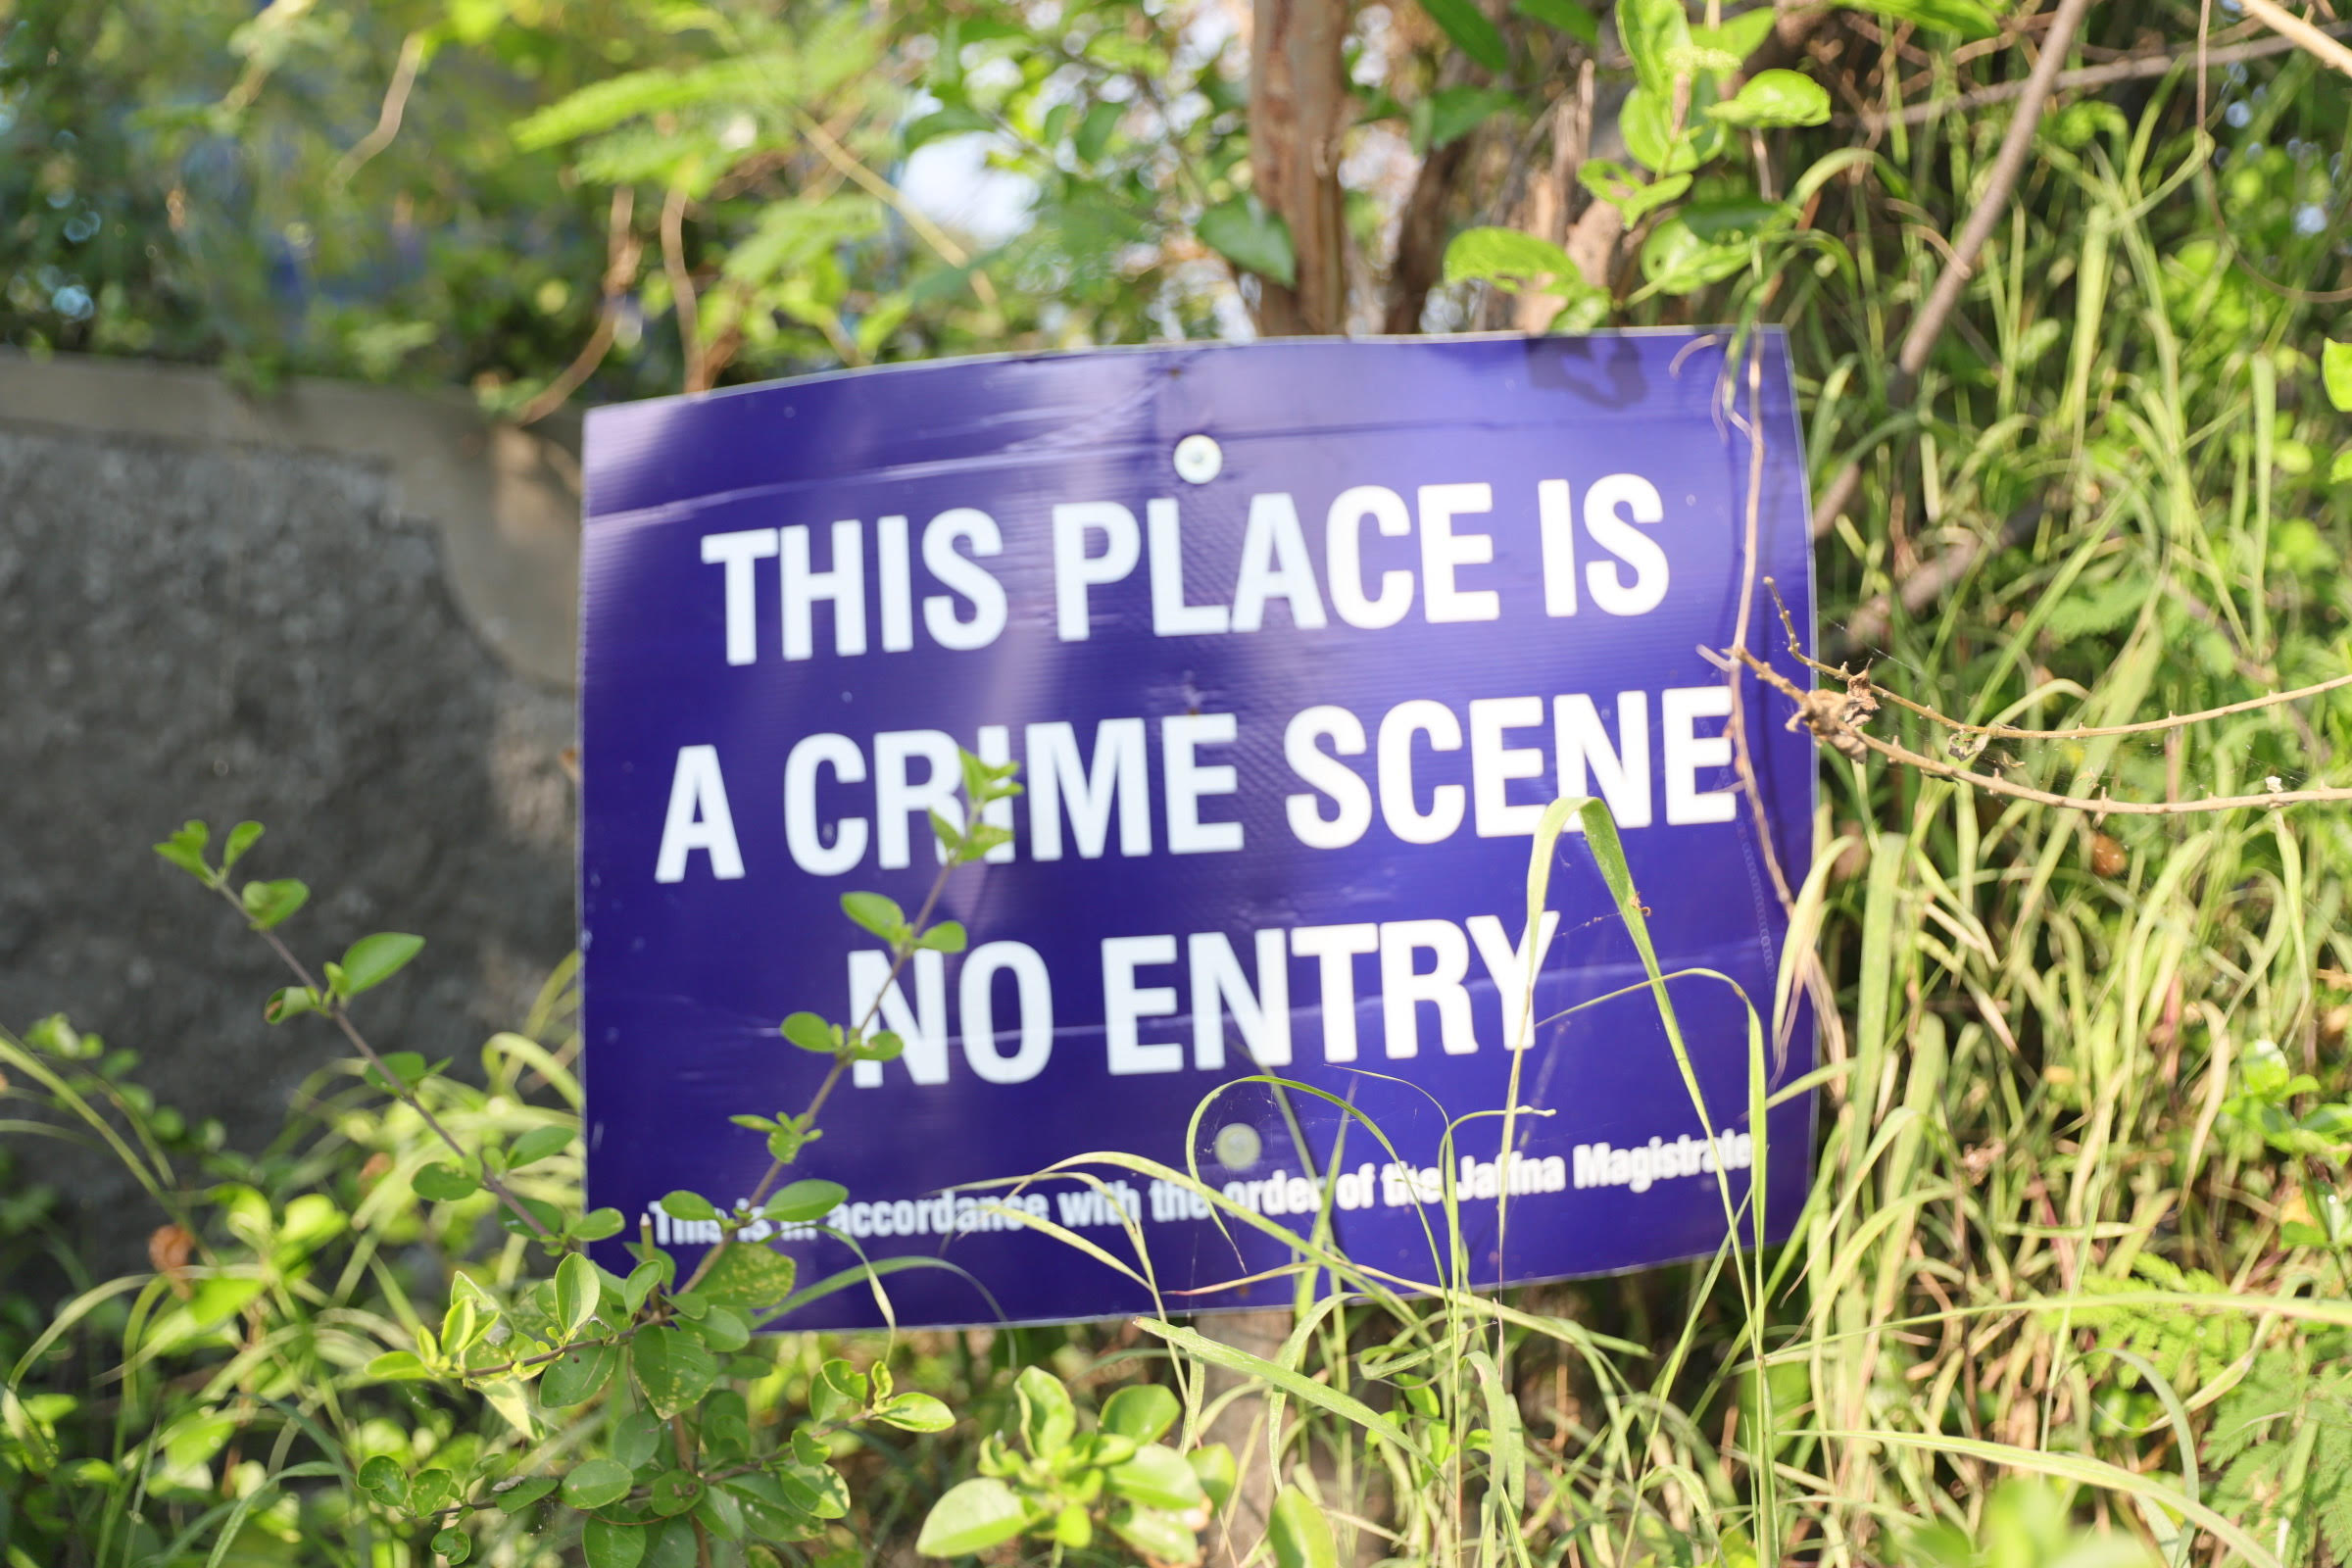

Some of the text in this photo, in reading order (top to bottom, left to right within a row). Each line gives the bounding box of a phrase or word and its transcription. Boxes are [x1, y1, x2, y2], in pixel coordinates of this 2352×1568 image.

[700, 473, 1670, 666] THIS PLACE IS
[655, 685, 1738, 884] A CRIME SCENE
[848, 910, 1561, 1089] NO ENTRY
[826, 1180, 1051, 1238] accordance
[1056, 1180, 1141, 1227] with
[1149, 1179, 1212, 1222] the
[1336, 1162, 1376, 1210] of
[1380, 1160, 1443, 1207] the
[1572, 1128, 1753, 1193] Magistrate
